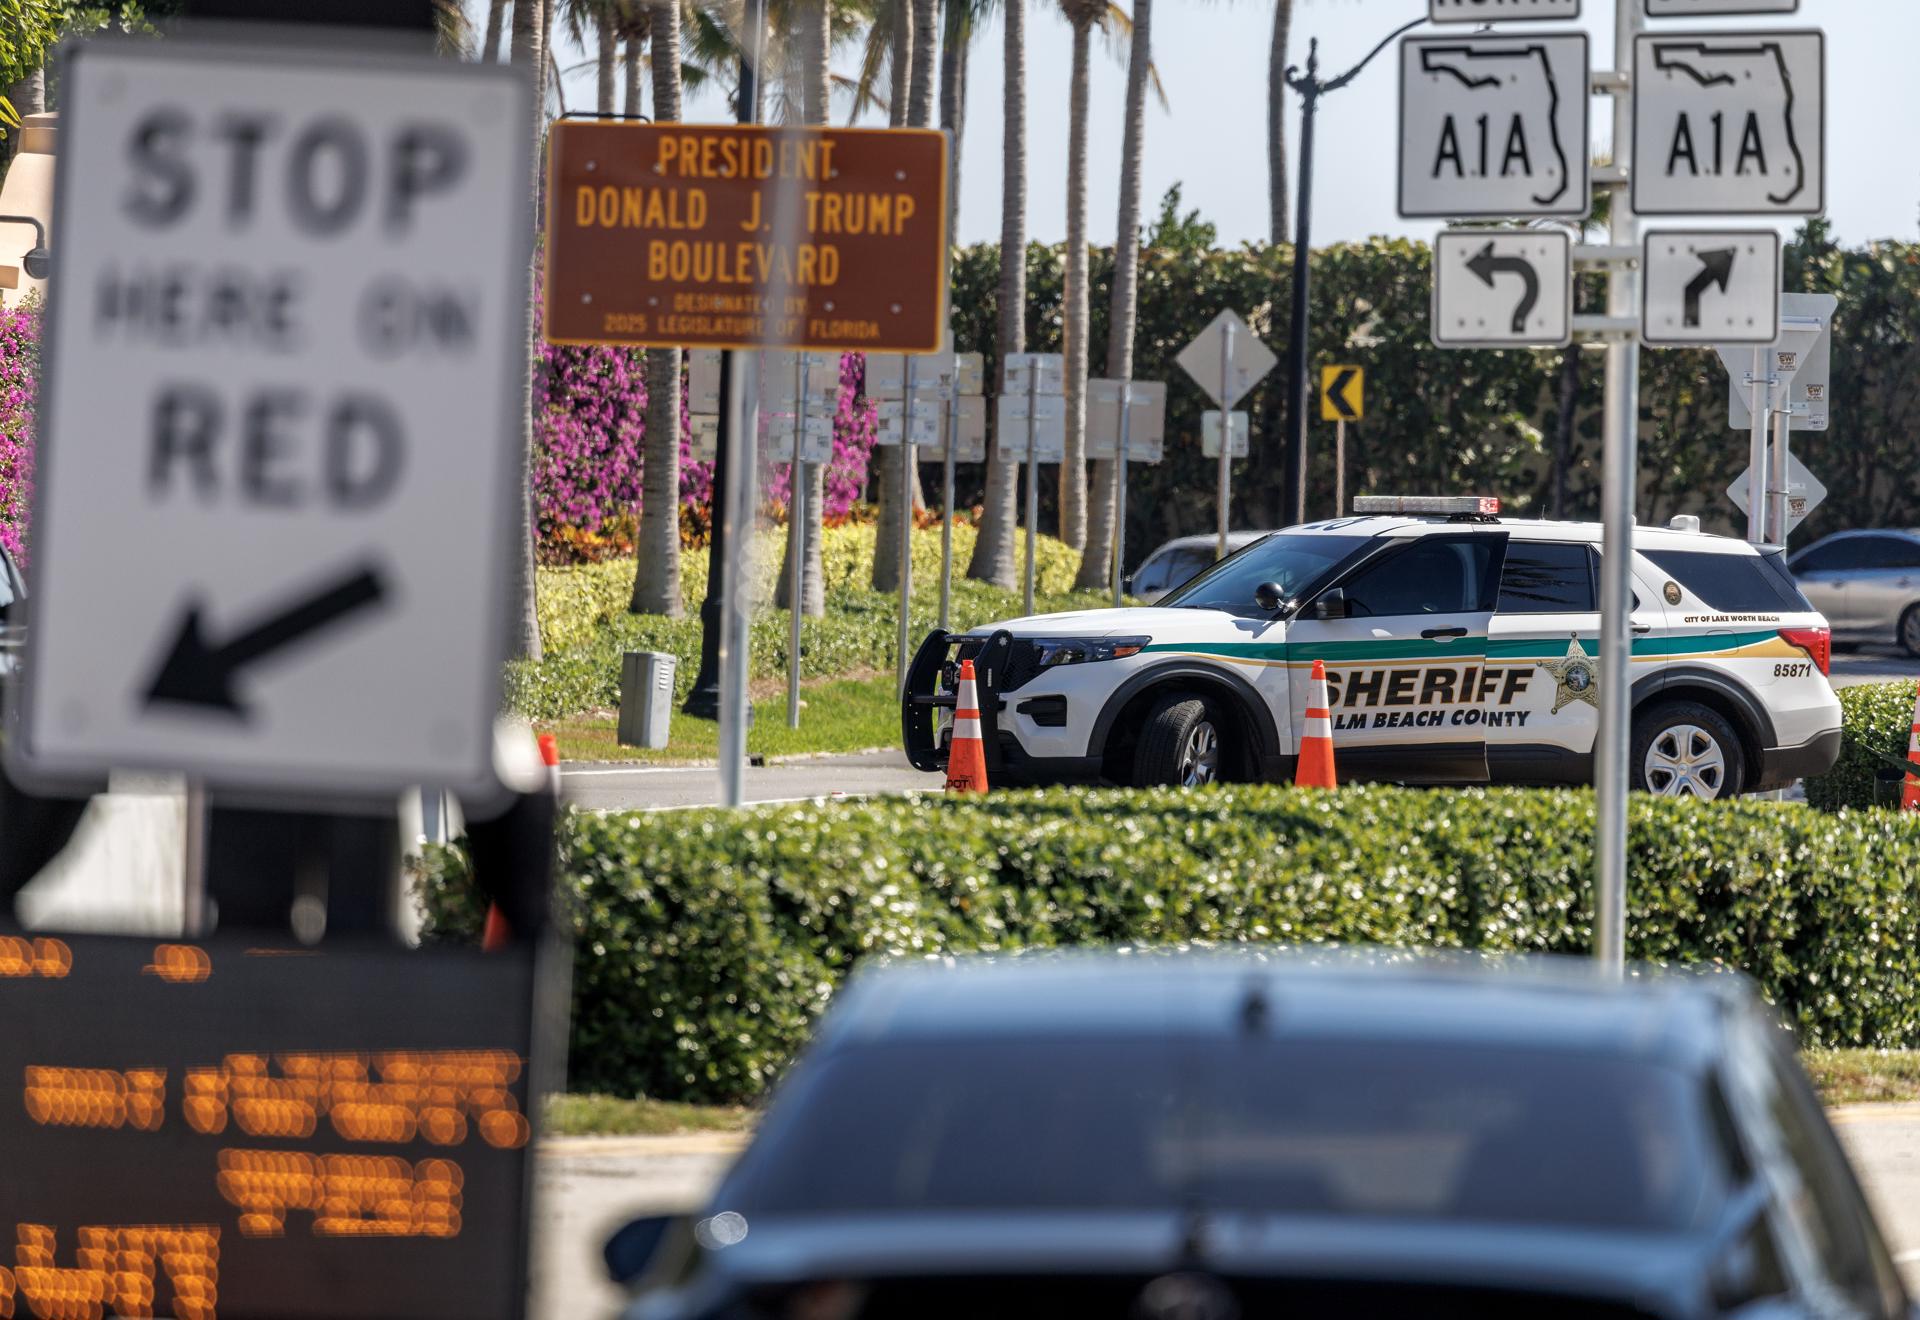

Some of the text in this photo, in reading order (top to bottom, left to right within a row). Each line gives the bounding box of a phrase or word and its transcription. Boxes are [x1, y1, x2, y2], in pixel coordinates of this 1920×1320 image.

[658, 135, 836, 180] PRESIDENT
[1432, 112, 1533, 177] A1A
[1667, 110, 1767, 176] A1A
[119, 107, 473, 240] STOP
[576, 185, 916, 235] DONALD J. TRUMP
[648, 240, 840, 286] BOULEVARD
[92, 258, 306, 354] HERE
[604, 313, 880, 339] 2025 LEGISLATURE OF FLORIDA
[144, 382, 406, 512] RED
[1325, 667, 1535, 707] SHERIFF
[1773, 664, 1811, 677] 85871
[1372, 710, 1445, 728] BEACH
